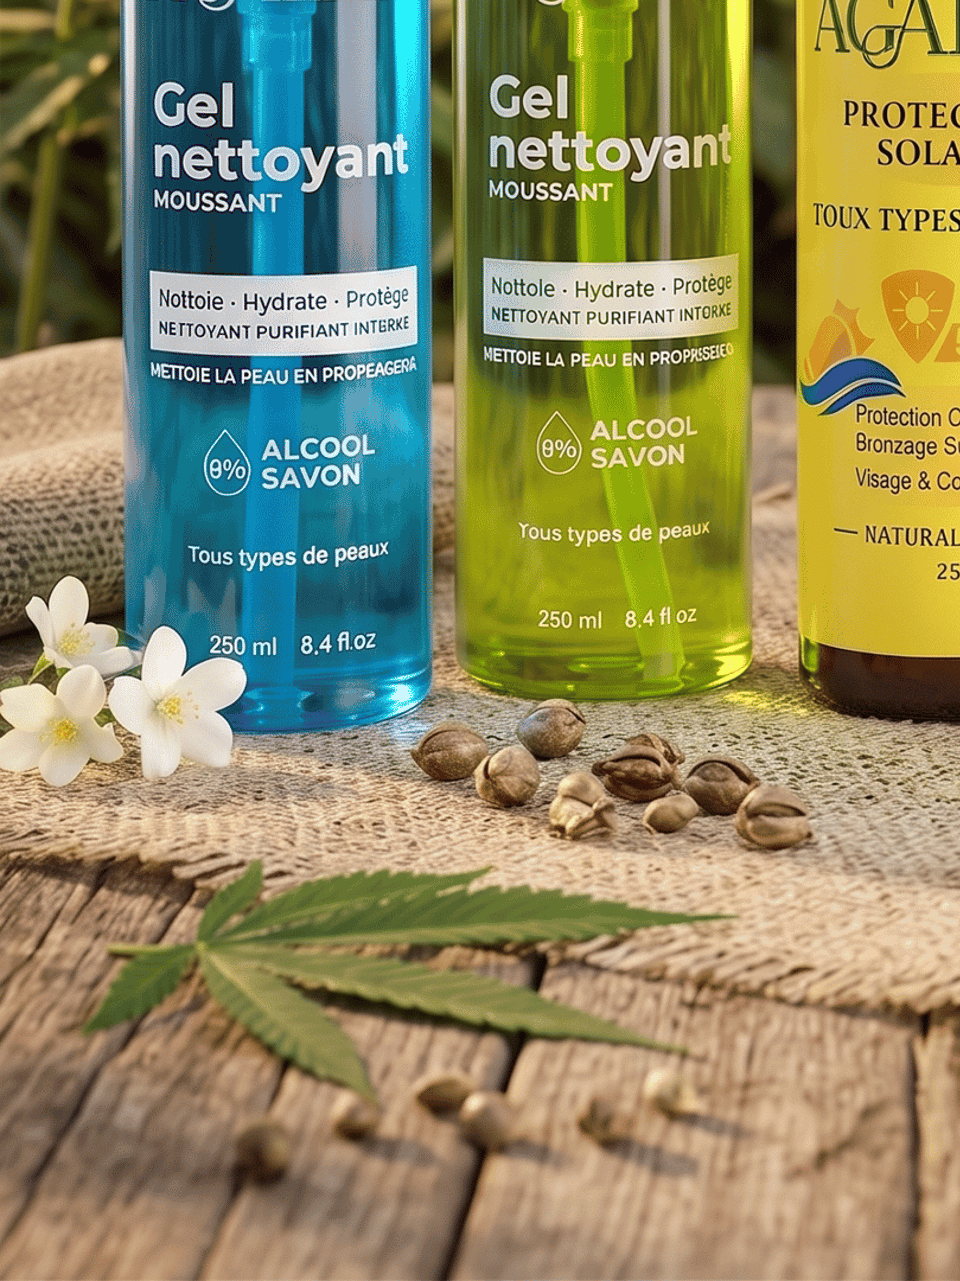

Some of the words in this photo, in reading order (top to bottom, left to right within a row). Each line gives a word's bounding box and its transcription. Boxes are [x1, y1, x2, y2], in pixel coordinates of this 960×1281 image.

[154, 81, 234, 128] Gel
[489, 73, 569, 120] Gel
[154, 133, 410, 193] nettoyant
[489, 124, 733, 182] nettoyant
[154, 189, 283, 213] MOUSSANT
[488, 179, 614, 202] MOUSSANT
[813, 202, 872, 230] TOUX
[574, 280, 655, 303] Hydrate
[243, 292, 328, 317] Hydrate
[491, 306, 581, 325] NETTOYANT
[586, 309, 675, 326] PURIFIANT
[159, 320, 251, 339] NETTOYANT
[257, 322, 349, 339] PURIFIANT
[546, 352, 565, 368] LA
[571, 353, 617, 368] PEAU
[622, 352, 645, 367] EN
[215, 368, 237, 384] LA
[241, 369, 290, 385] PEAU
[294, 368, 318, 384] EN
[856, 403, 942, 427] Protection
[590, 416, 697, 441] ALCOOL
[261, 433, 376, 461] ALCOOL
[590, 443, 685, 470] SAVON
[856, 432, 937, 460] Bronzage
[261, 462, 361, 490] SAVON
[855, 467, 912, 495] Visage
[917, 471, 931, 490] &
[568, 526, 623, 547] types
[628, 524, 653, 542] de
[658, 521, 711, 544] peaux
[865, 524, 960, 547] NATURAL
[188, 545, 233, 566] Tous
[238, 546, 297, 571] types
[302, 544, 328, 565] de
[334, 541, 389, 567] peaux
[538, 609, 573, 629] 250
[579, 611, 602, 629] ml
[625, 610, 654, 629] 8.4
[676, 608, 697, 623] oz
[209, 635, 246, 655] 250
[252, 636, 277, 656] ml
[300, 633, 333, 656] 8.4
